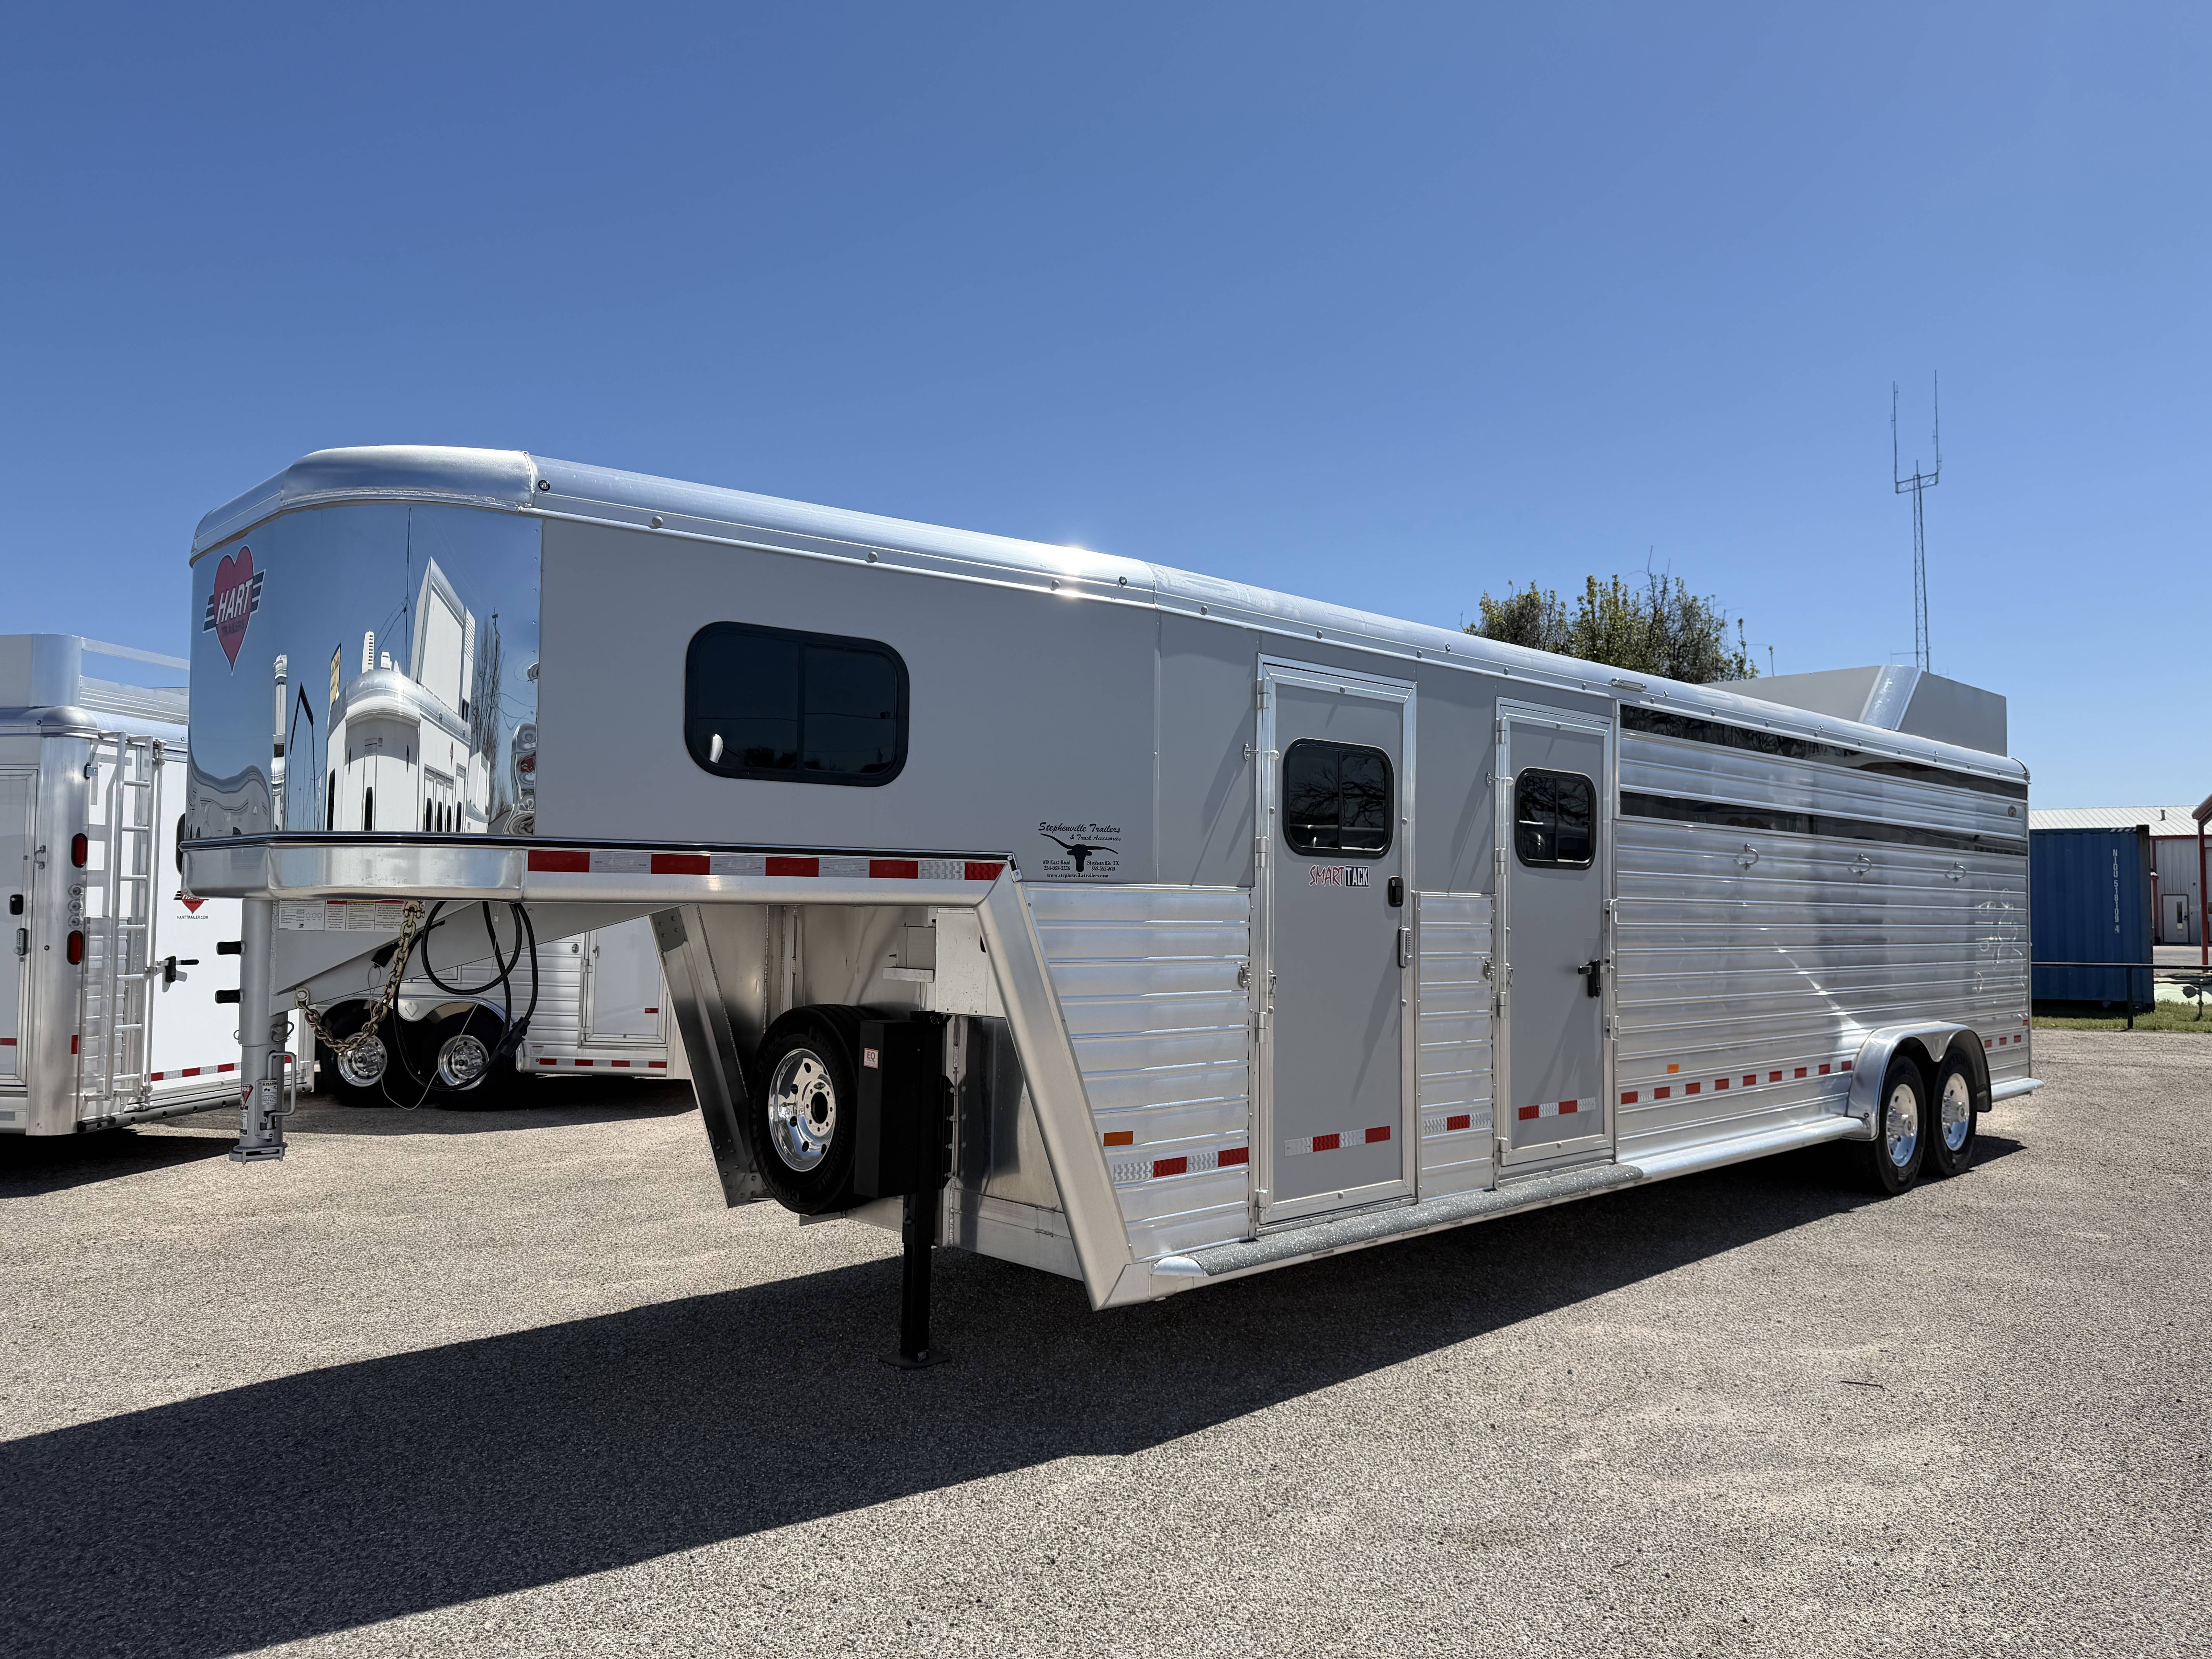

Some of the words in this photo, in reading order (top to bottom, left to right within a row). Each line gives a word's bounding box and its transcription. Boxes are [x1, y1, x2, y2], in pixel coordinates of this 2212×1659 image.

[216, 579, 253, 624] HART
[221, 620, 245, 637] TRAILERS
[1038, 822, 1087, 833] Stephenville
[1089, 823, 1121, 833] Trailers
[1309, 865, 1345, 886] SMART
[1346, 867, 1368, 886] TACK
[867, 1051, 875, 1063] EQ
